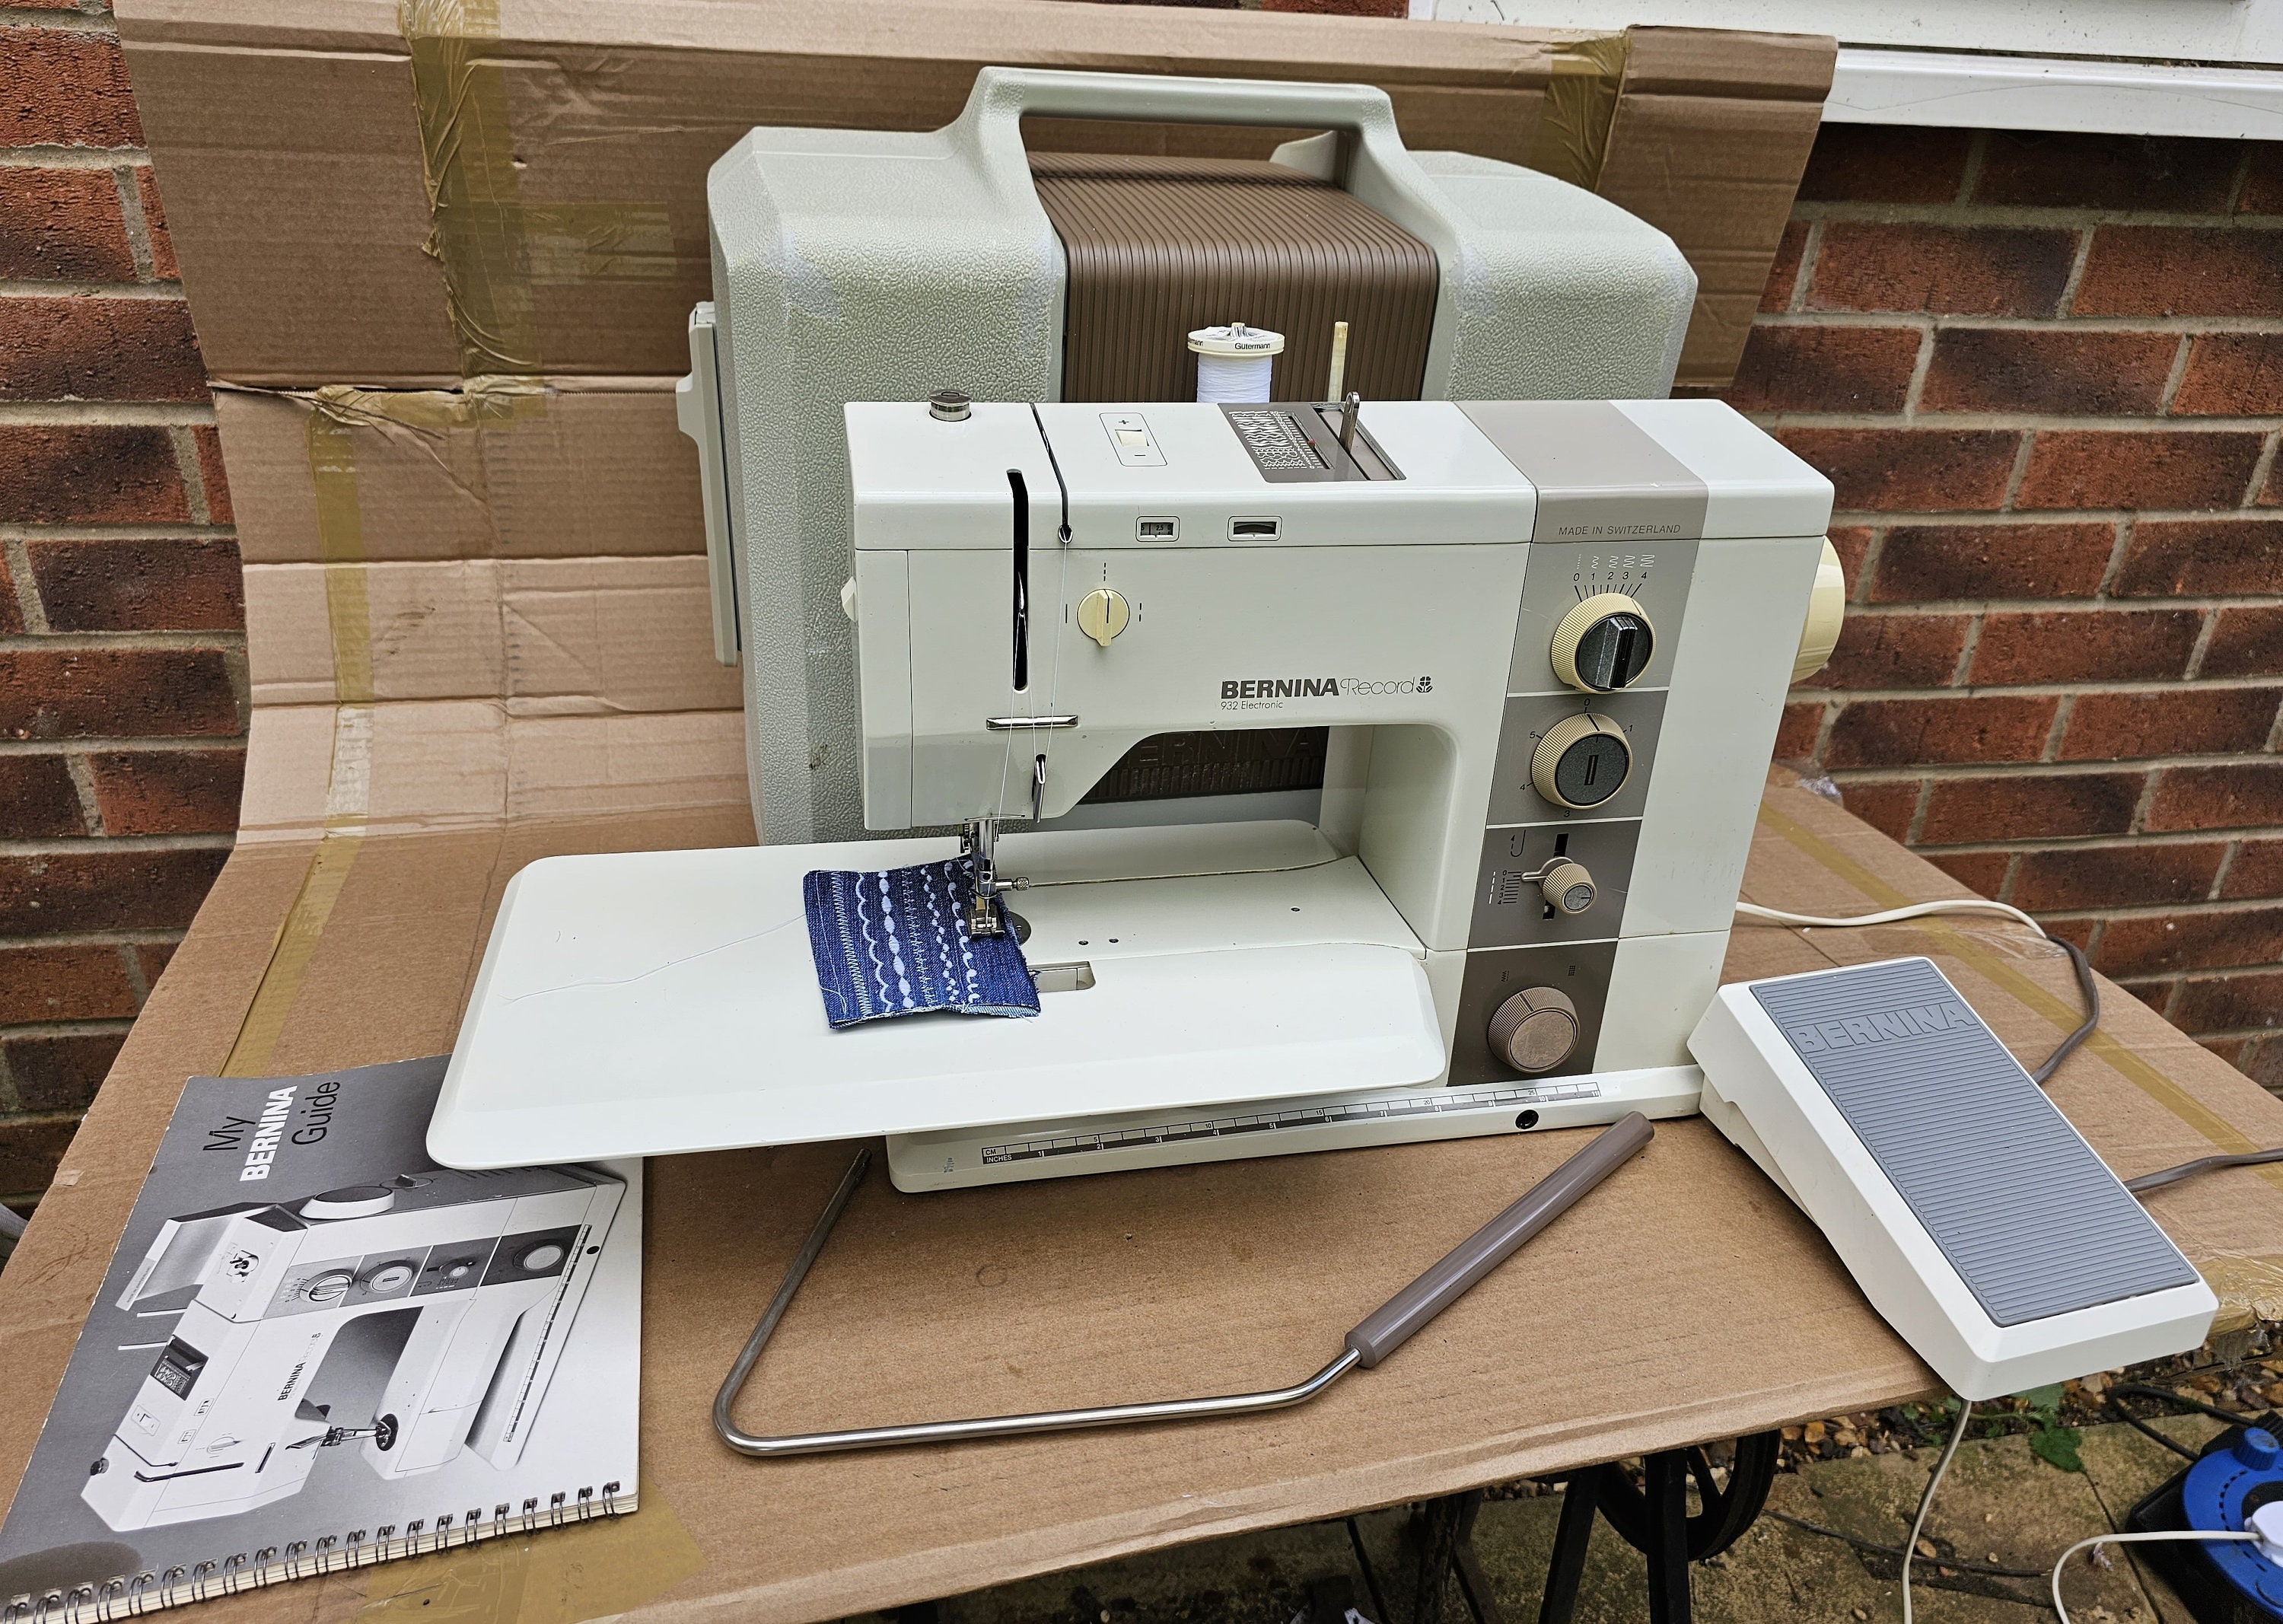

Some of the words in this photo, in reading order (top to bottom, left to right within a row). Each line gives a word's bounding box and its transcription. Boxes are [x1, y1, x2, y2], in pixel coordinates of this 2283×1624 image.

[1559, 525, 1588, 536] MADE
[1592, 525, 1603, 535] IN
[1607, 524, 1681, 534] SWITZERLAND
[1573, 572, 1580, 581] 0
[1607, 572, 1614, 580] 2
[1622, 572, 1629, 580] 3
[1641, 572, 1648, 580] 4
[1221, 678, 1339, 699] BERNINA
[1339, 677, 1415, 696] Record
[1221, 701, 1238, 711] 932
[1240, 699, 1284, 710] Electronic
[1628, 724, 1634, 732] 1
[1785, 998, 1978, 1054] BERNINA
[291, 1081, 340, 1145] Guide
[202, 1116, 256, 1151] My
[239, 1085, 298, 1181] BERNINA
[986, 1154, 1012, 1164] INCHES
[277, 1362, 306, 1401] BERNINA
